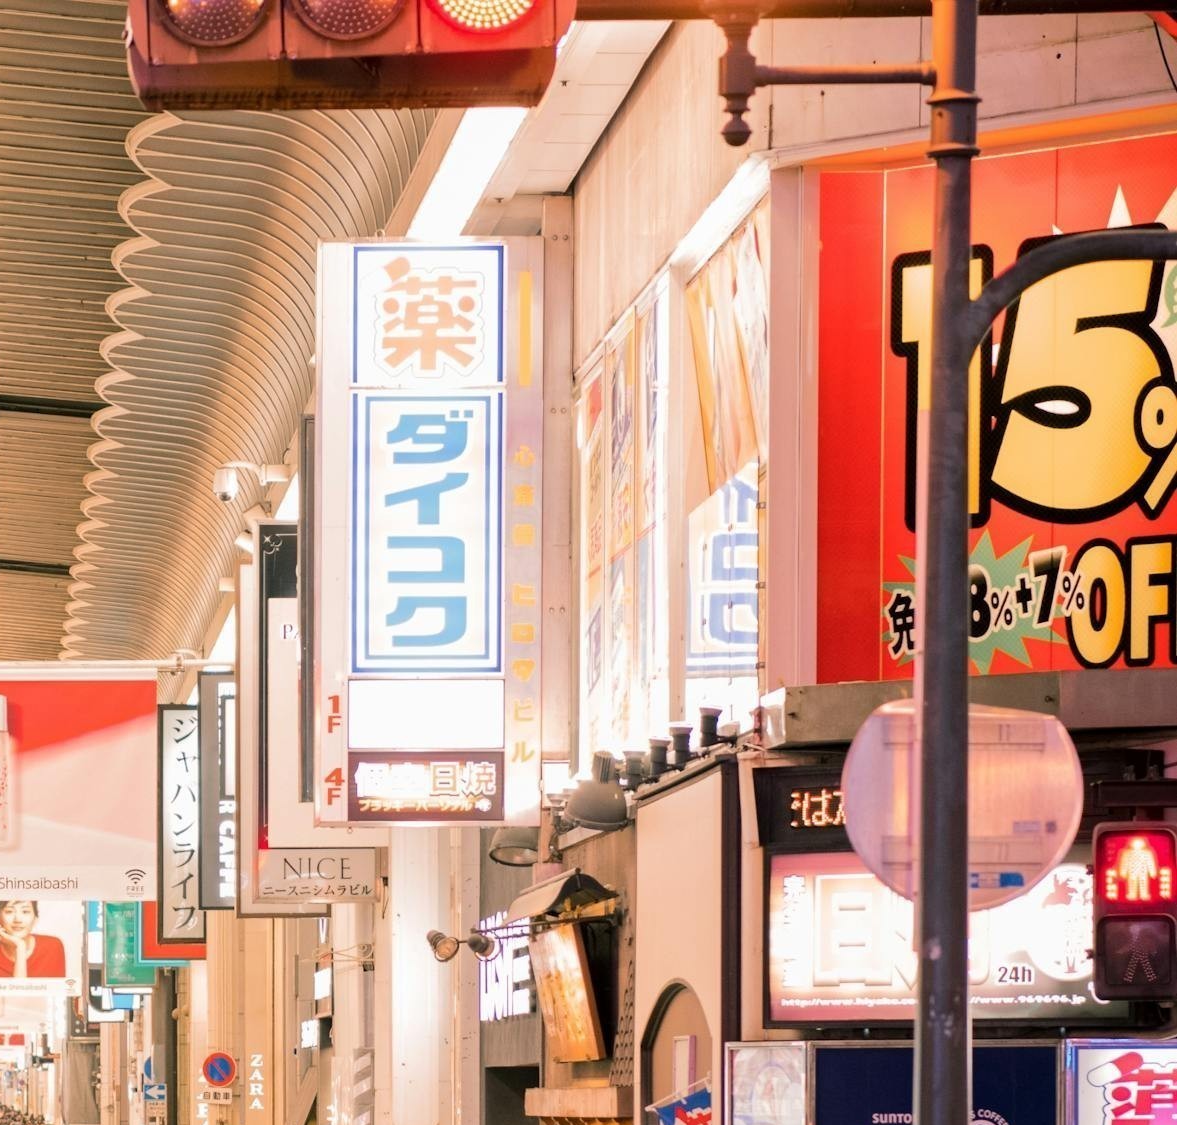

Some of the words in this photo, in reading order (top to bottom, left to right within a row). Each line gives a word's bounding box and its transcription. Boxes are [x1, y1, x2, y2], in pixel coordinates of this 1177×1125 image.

[379, 256, 478, 378] 薬
[383, 408, 475, 649] ダイコク
[1069, 535, 1177, 670] OF
[327, 695, 343, 735] 1F
[324, 767, 346, 806] 4F
[283, 857, 353, 880] NICE
[263, 883, 373, 896] ニースニシムラビル
[997, 965, 1033, 984] 24h
[249, 1053, 264, 1109] ZARA
[872, 1112, 913, 1124] SUNTO
